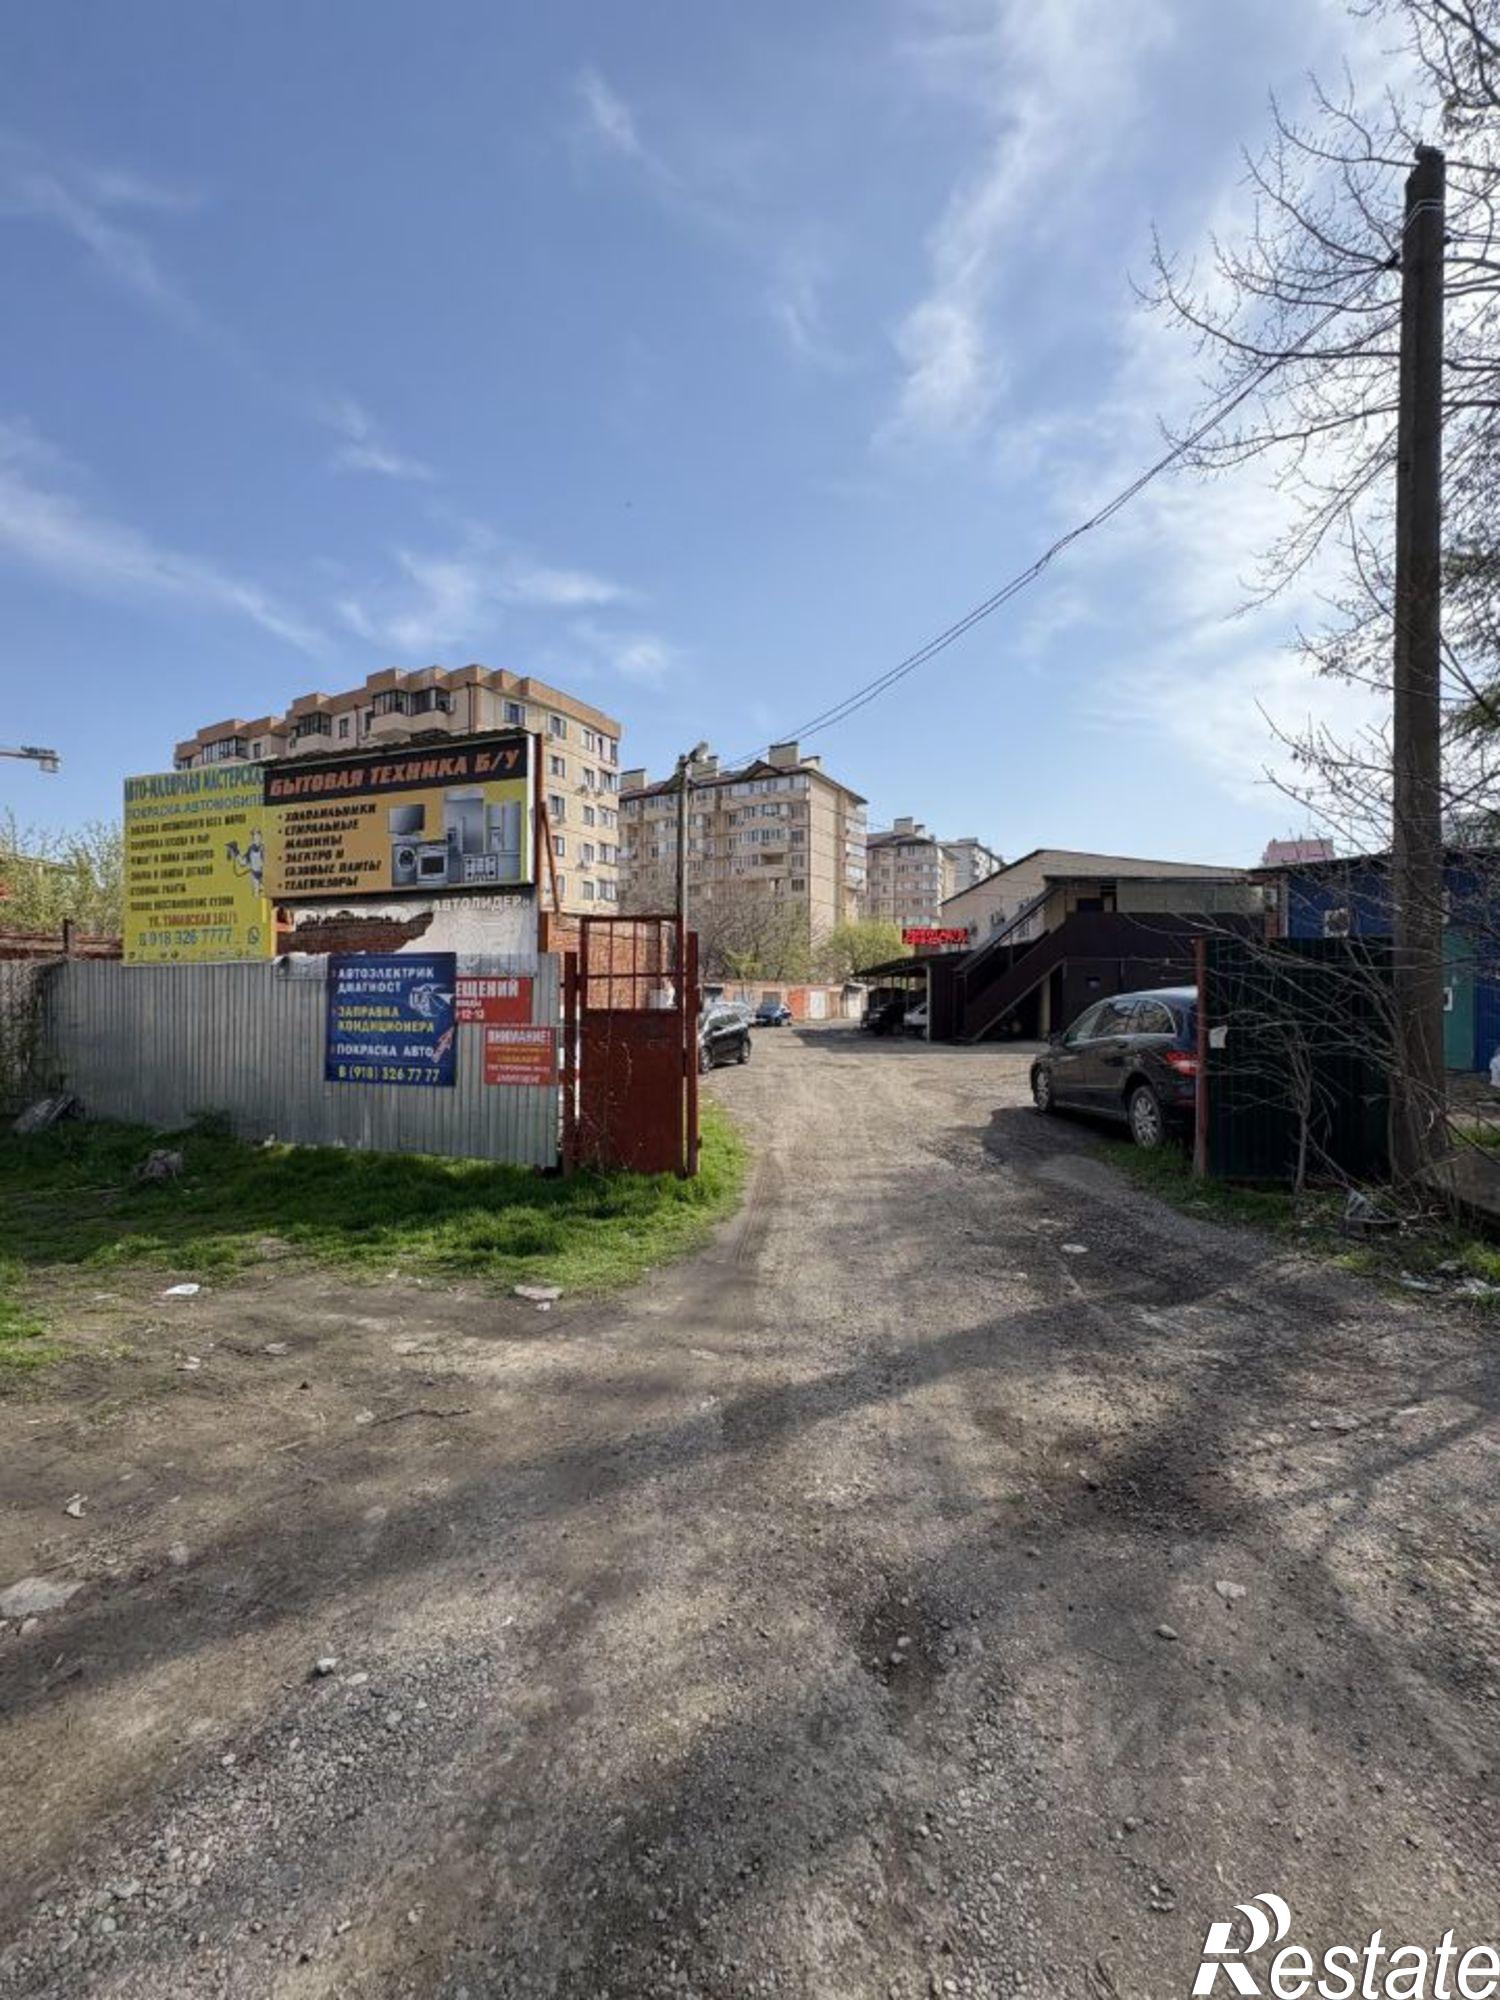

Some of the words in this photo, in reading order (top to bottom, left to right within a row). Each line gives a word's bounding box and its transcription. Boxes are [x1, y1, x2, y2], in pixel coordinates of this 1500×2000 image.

[269, 769, 365, 797] БЫТОВАЯ
[370, 755, 468, 785] ТЕХНИКА
[474, 749, 520, 774] Б/У
[184, 794, 265, 813] АВТОМОБИЛЕ
[284, 804, 377, 822] ХОЛОДИЛЬНИКИ
[284, 819, 359, 836] СТИРАЛЬНЫЕ
[284, 834, 343, 849] МАШИНЫ
[285, 850, 333, 863] ЭЛЕКТРО
[335, 848, 345, 859] И
[284, 863, 336, 877] ГАЗОВЫЕ
[339, 860, 382, 873] ПЛИТЫ
[284, 876, 359, 891] ТЕЛЕВИЗОРЫ
[148, 930, 171, 945] 918
[338, 966, 435, 980] АВТОЭЛЕКТРИК
[337, 981, 401, 994] ДИАГНОСТ
[456, 979, 520, 998] ЕЩЕНИЙ
[338, 1005, 401, 1018] ЗАПРАВКА
[337, 1020, 435, 1034] КОНДИЦИОНЕРА
[336, 1042, 398, 1057] ПОКРАСКА
[403, 1045, 435, 1058] АВТО
[338, 1063, 348, 1078] 8
[348, 1065, 379, 1081] (918)
[407, 1068, 423, 1081] 77
[425, 1068, 441, 1083] 77
